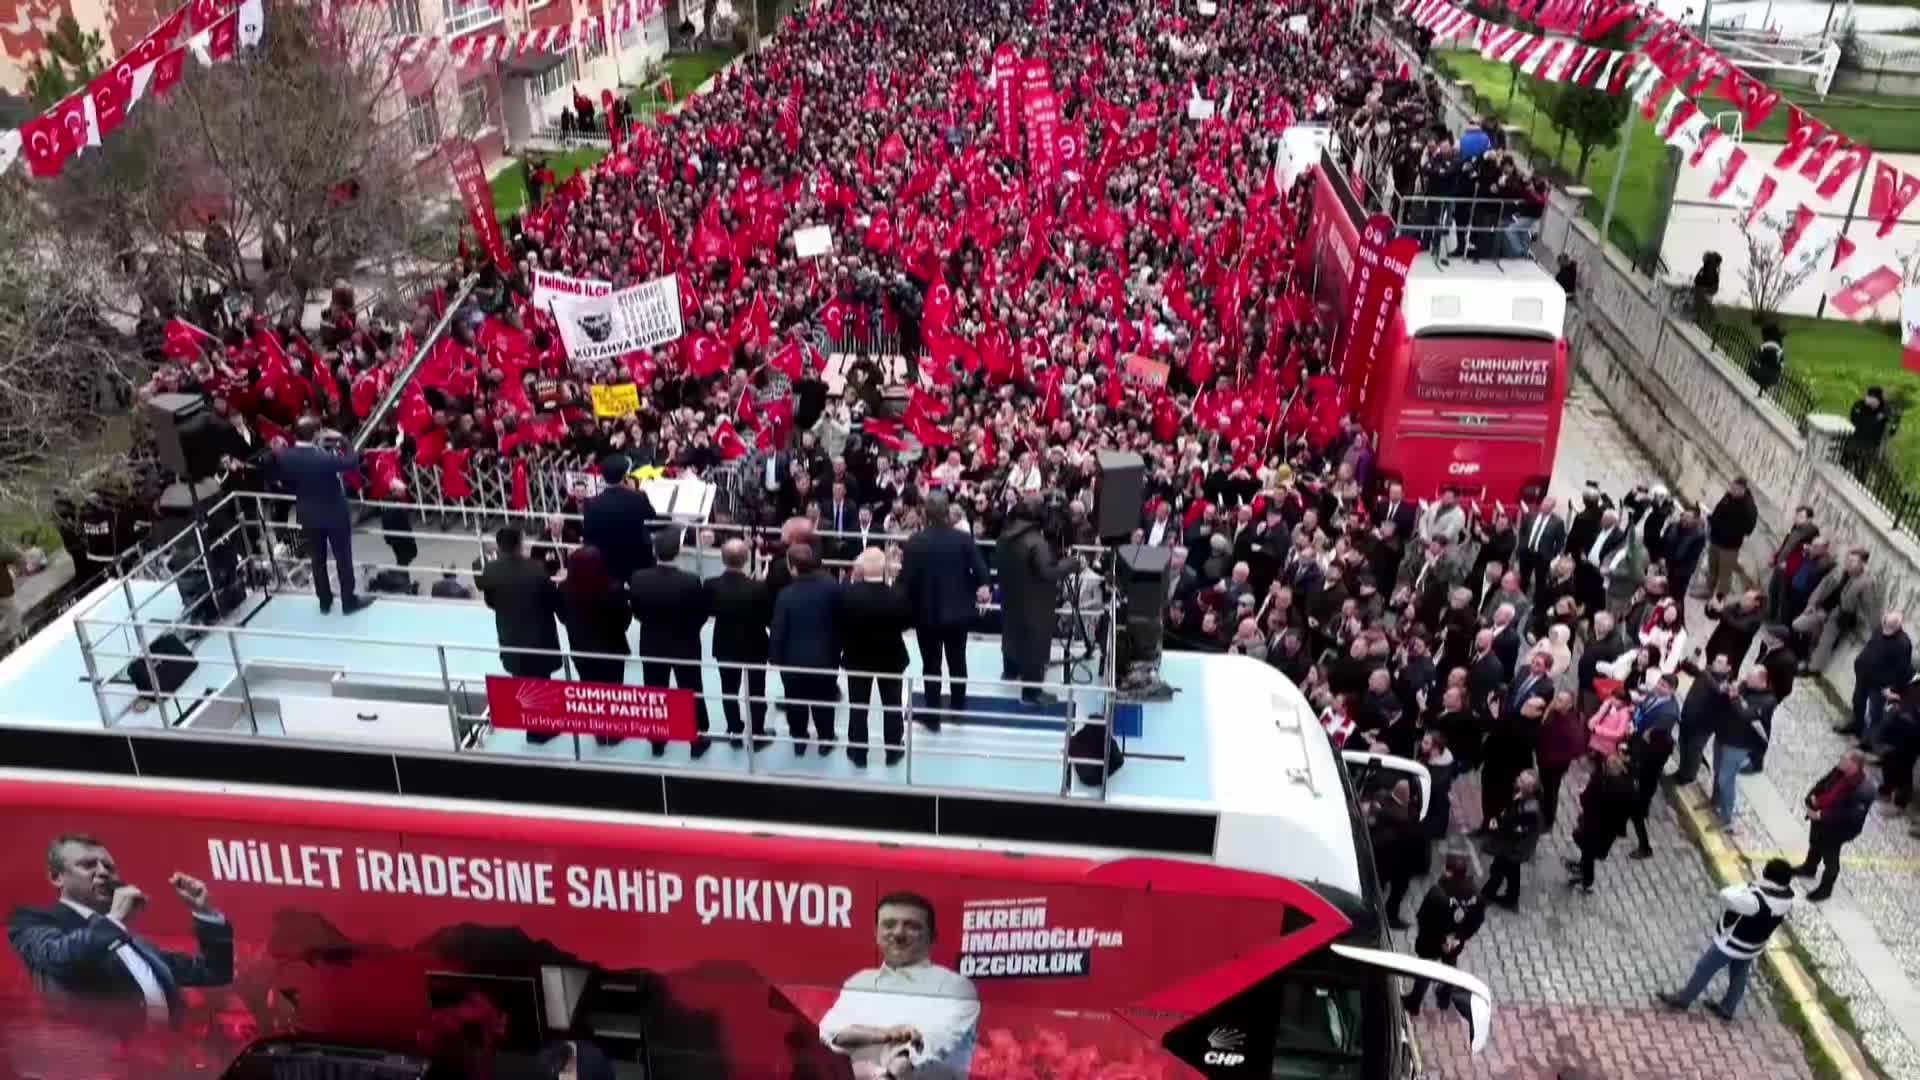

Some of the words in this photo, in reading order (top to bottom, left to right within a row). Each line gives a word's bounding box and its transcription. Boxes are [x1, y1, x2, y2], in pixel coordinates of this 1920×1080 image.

[1460, 357, 1549, 371] CUMHURİYET
[1459, 371, 1494, 384] HALK
[1497, 373, 1548, 386] PARTİSİ
[1449, 461, 1480, 474] CHP
[564, 686, 667, 705] CUMHURİYET
[566, 702, 605, 715] HALK
[610, 704, 668, 720] PARTİSİ
[695, 874, 852, 928] ÇIKIYOR
[963, 907, 1047, 930] EKREM
[959, 952, 1084, 977] ÖZGÜRLÜK
[1204, 1051, 1245, 1066] CHP
